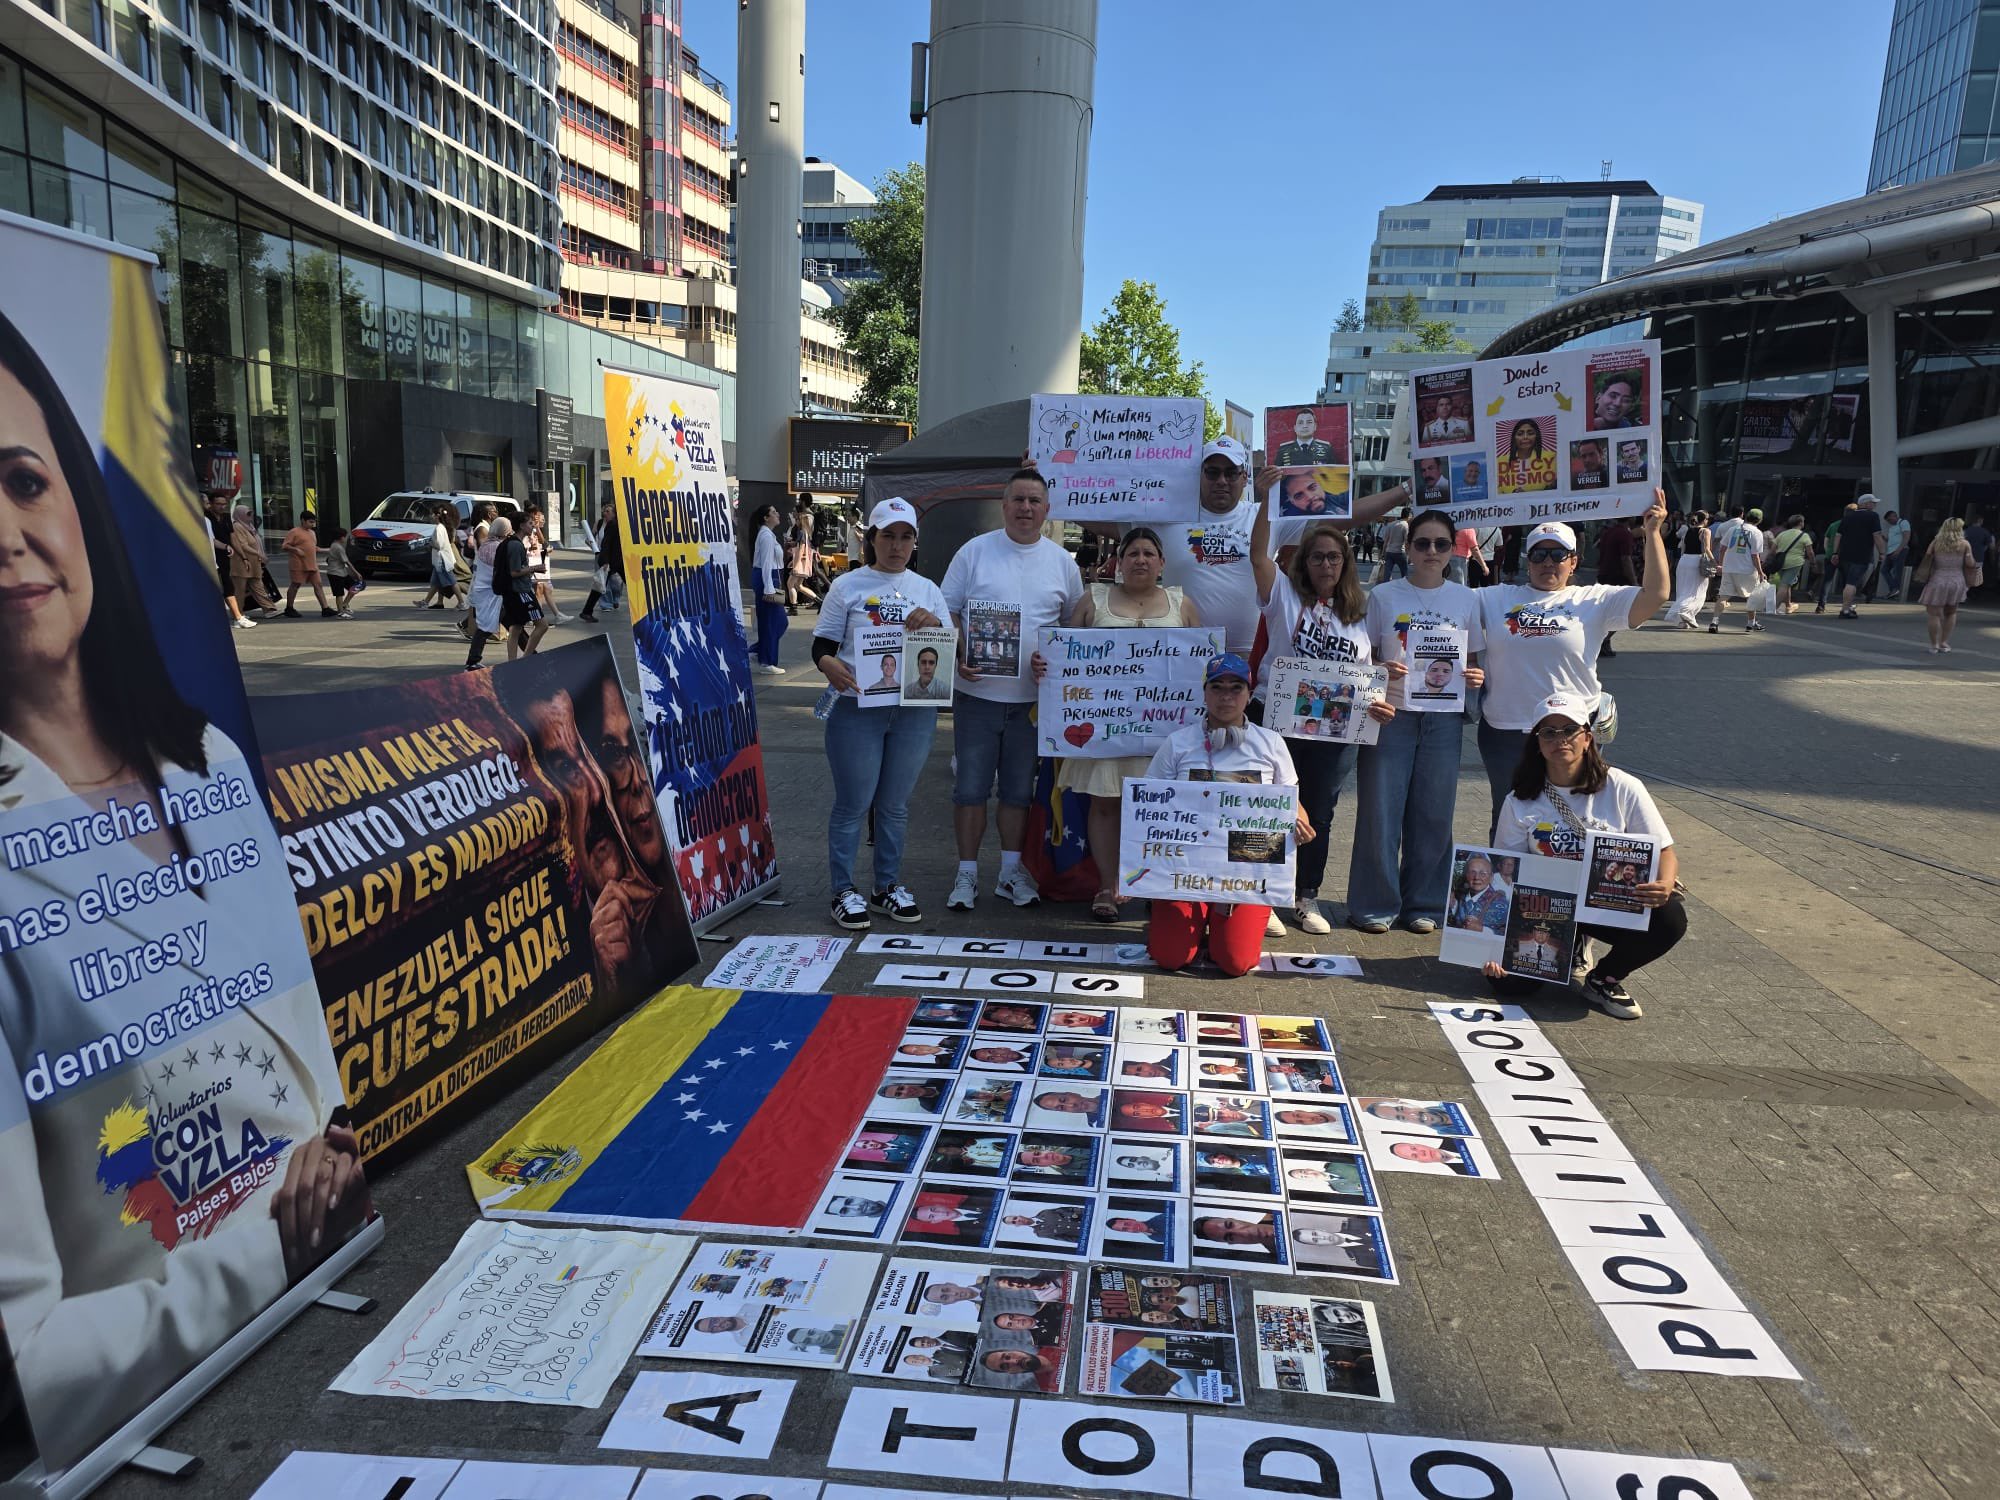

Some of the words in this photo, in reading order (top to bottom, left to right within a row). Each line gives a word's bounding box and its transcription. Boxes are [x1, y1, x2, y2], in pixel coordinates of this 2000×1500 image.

[396, 338, 412, 355] OF
[684, 429, 704, 445] CON
[1093, 430, 1115, 442] UNA
[1118, 429, 1155, 442] MADRE
[685, 444, 715, 465] VZLA
[211, 457, 237, 489] SALE
[1498, 456, 1555, 476] DELCY
[1622, 471, 1643, 479] VERGEL
[1498, 469, 1556, 487] NISMO
[1577, 475, 1602, 485] VERGEL
[621, 476, 731, 545] Venezuelans
[1529, 503, 1549, 519] DEL
[1202, 538, 1225, 547] CON
[1202, 545, 1239, 555] VZLA
[641, 554, 711, 632] fighting
[708, 553, 732, 613] for
[970, 601, 1022, 612] DESAPARECIDOS
[1518, 617, 1559, 627] VZLA
[862, 631, 903, 640] FRANCISCO
[869, 639, 897, 647] VALERA
[1415, 644, 1459, 652] GONZÁLEZ
[1062, 667, 1080, 678] NO
[1086, 664, 1145, 677] BORDERS
[1318, 664, 1330, 673] de
[1338, 664, 1387, 681] Asesinatos
[1063, 684, 1094, 703] FREE
[655, 702, 727, 775] freedom
[728, 687, 758, 754] and
[275, 745, 398, 818] MISMA
[381, 718, 502, 781] MAFIA,
[388, 752, 529, 837] VERDUGO:
[1130, 783, 1176, 803] TRUMP
[1217, 790, 1241, 808] THE
[673, 765, 761, 849] democracy
[1135, 807, 1169, 822] HEAR
[1173, 810, 1198, 825] THE
[2, 797, 158, 871] marcha
[160, 772, 250, 826] hacia
[1142, 843, 1185, 859] FREE
[1597, 847, 1648, 860] HERMANOS
[77, 837, 261, 924] elecciones
[298, 861, 403, 958] DELCY
[407, 844, 448, 902] ES
[447, 796, 548, 881] MADURO
[1171, 873, 1214, 890] THEM
[1520, 895, 1550, 913] 500
[70, 932, 183, 1002] libres
[183, 920, 207, 967] y
[325, 915, 483, 1048] ENEZUELA
[485, 867, 552, 944] SIGUE
[901, 970, 1120, 993] LOS
[340, 905, 570, 1110] CUESTRADA!
[23, 962, 273, 1102] democráticas
[359, 1102, 422, 1157] CONTRA
[426, 1084, 443, 1112] LA
[449, 1034, 518, 1098] DICTADURA
[520, 981, 590, 1047] HEREDITARIA!
[149, 1076, 233, 1136] Voluntarios
[154, 1102, 223, 1166] CON
[160, 1117, 268, 1205] VZLA
[231, 1155, 275, 1196] Bajos
[1450, 1006, 1759, 1360] POLITICOS
[882, 1269, 899, 1299] WLADIMIR
[890, 1275, 908, 1308] ESCALONA
[1101, 1290, 1132, 1318] 500
[472, 1339, 530, 1386] PUERTO
[506, 1282, 568, 1337] CABELLO
[659, 1313, 674, 1335] MEDINA
[761, 1320, 781, 1349] ARGENIS
[770, 1323, 788, 1347] UGUETO
[858, 1335, 872, 1360] LEONARDO
[877, 1339, 888, 1356] PARRA
[1090, 1326, 1100, 1357] HERMANOS
[863, 1346, 876, 1368] LEANDRO
[1089, 1357, 1097, 1370] LOS
[1087, 1370, 1095, 1392] FALTAN
